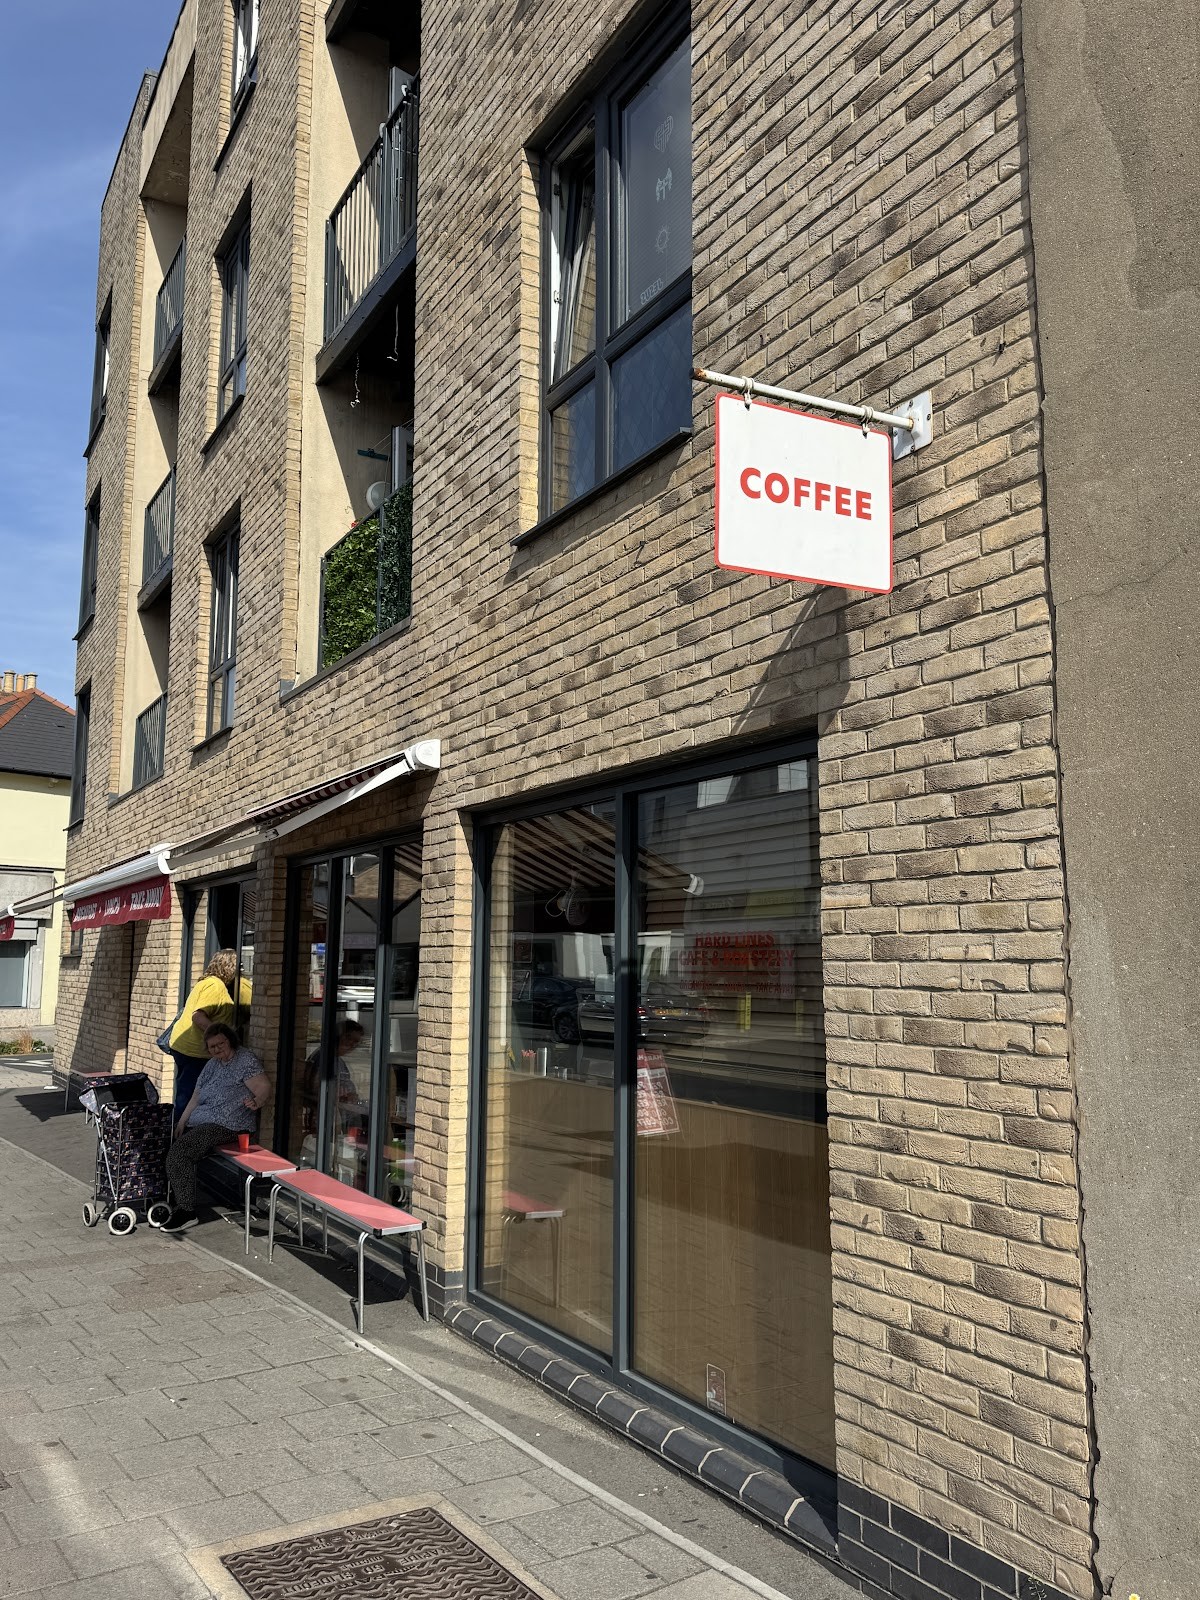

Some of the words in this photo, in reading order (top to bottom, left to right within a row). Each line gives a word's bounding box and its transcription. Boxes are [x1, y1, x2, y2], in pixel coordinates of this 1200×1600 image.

[740, 467, 872, 521] COFFEE
[695, 932, 731, 948] HARD
[734, 930, 775, 948] LINES
[678, 950, 709, 966] CAFE
[723, 949, 796, 967] ROASTERY
